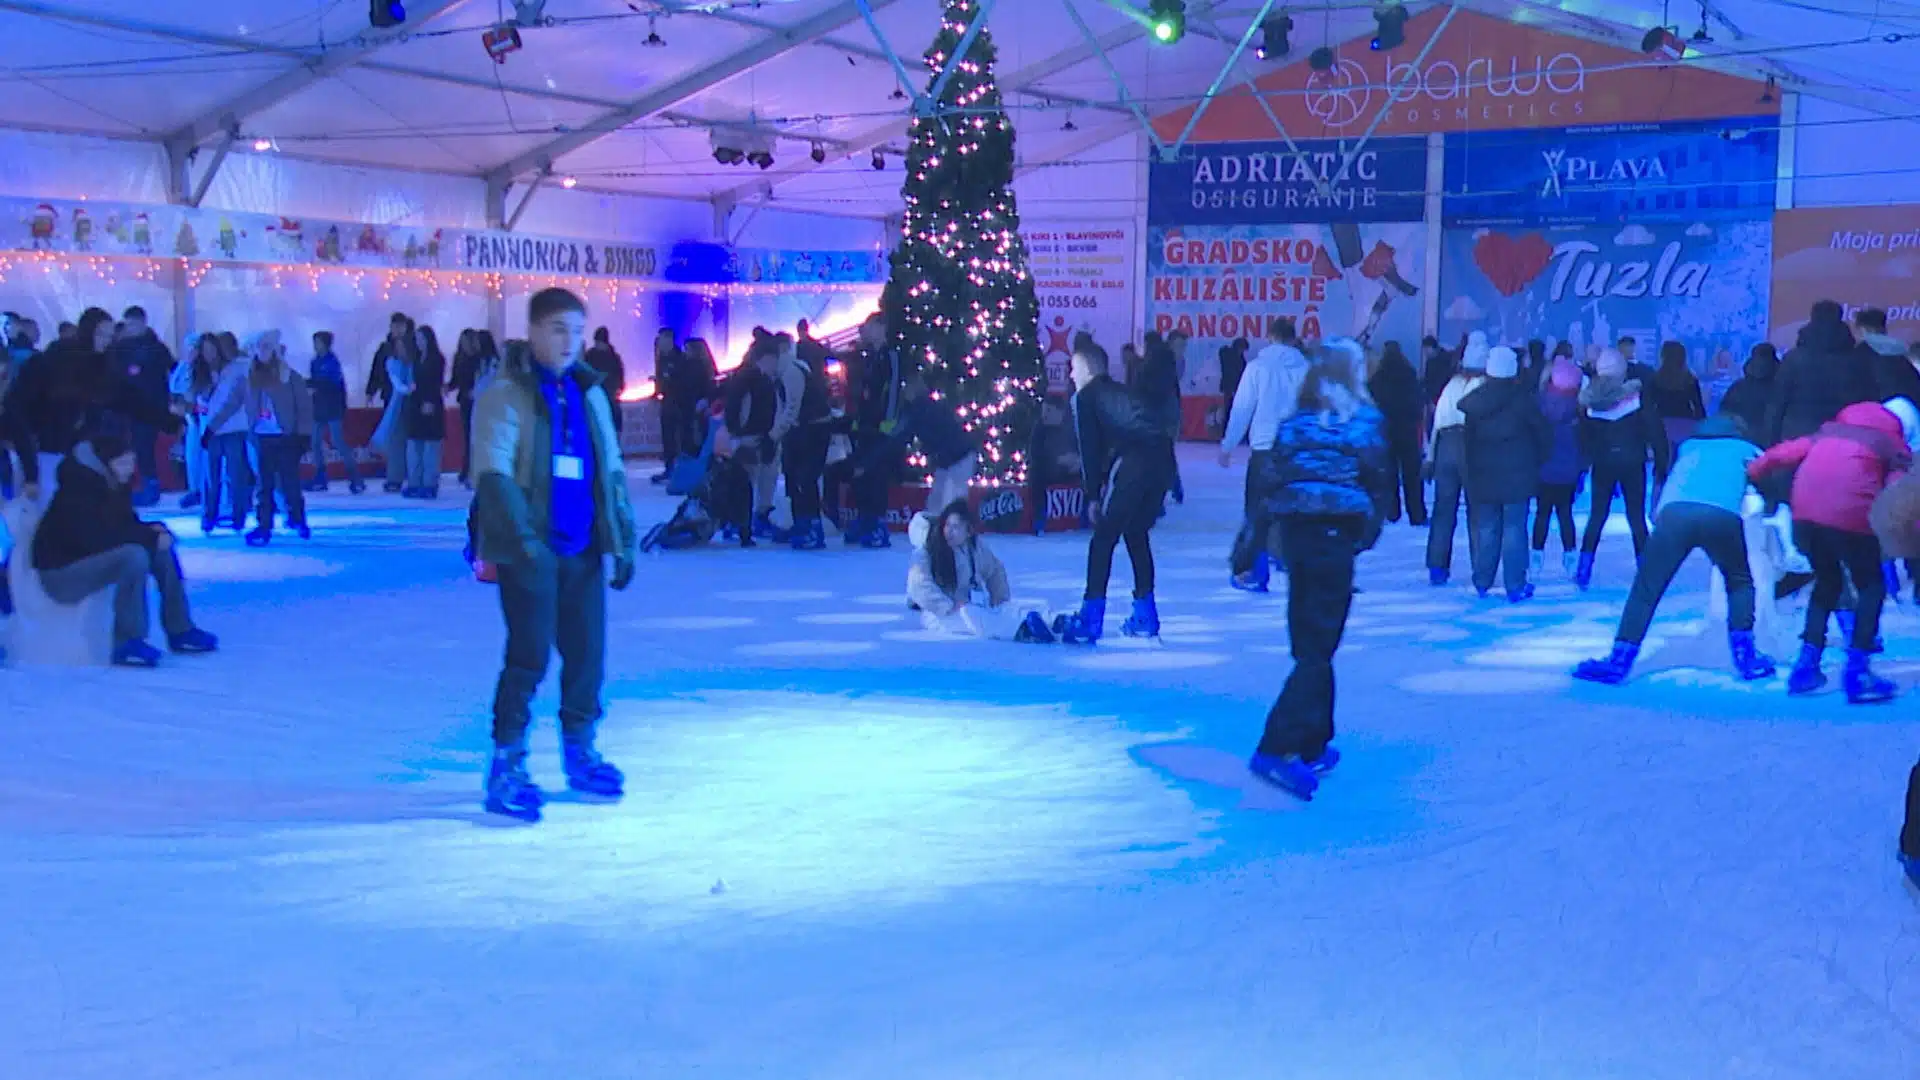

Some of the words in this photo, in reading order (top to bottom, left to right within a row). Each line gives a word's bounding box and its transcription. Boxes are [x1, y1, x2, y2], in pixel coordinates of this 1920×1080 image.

[1386, 53, 1585, 102] barwa
[1193, 151, 1377, 183] ADRIATIC
[1565, 156, 1666, 181] PLAVA
[1191, 187, 1377, 210] OSIGURANJE
[1166, 238, 1316, 265] GRADSKO
[1830, 230, 1883, 253] Moja
[584, 244, 599, 274] &
[604, 246, 657, 276] BINGO
[1552, 240, 1712, 302] Tuzla
[1154, 271, 1326, 302] KLIZALIŠTE
[1047, 295, 1070, 308] 055
[1073, 295, 1097, 308] 066
[1155, 313, 1322, 339] PANONIA
